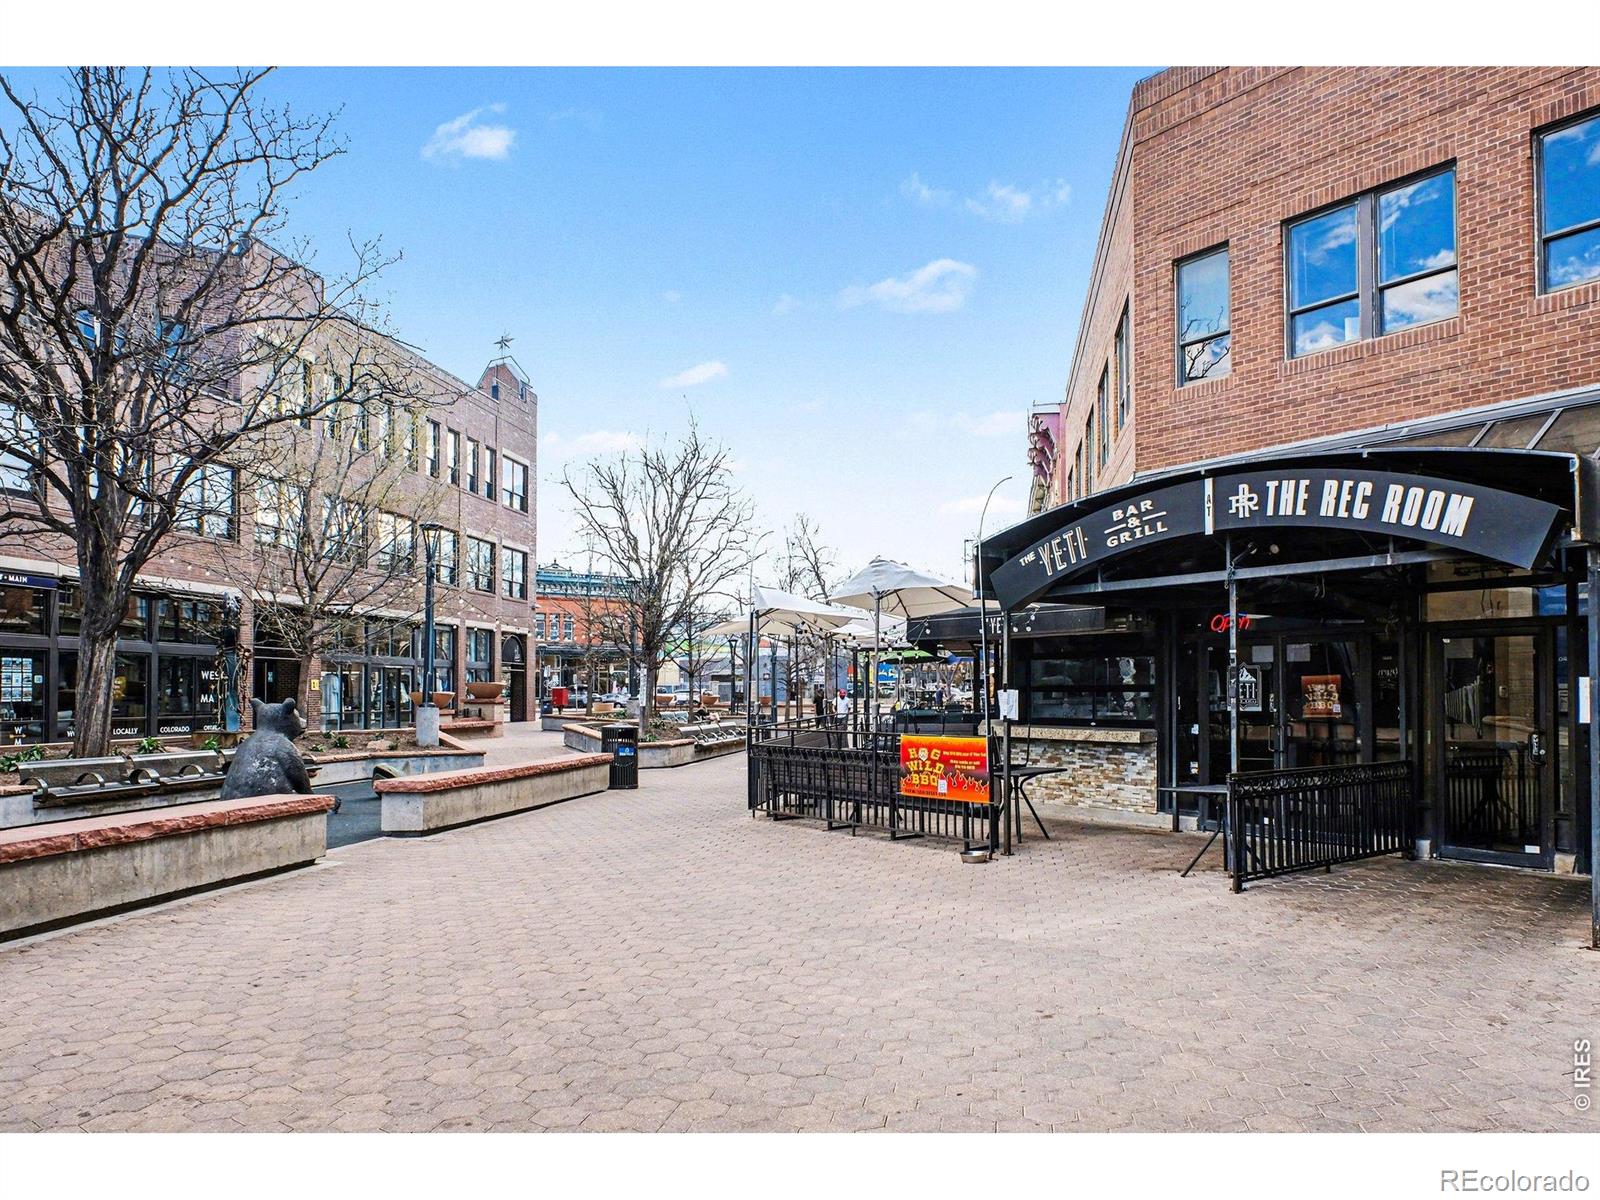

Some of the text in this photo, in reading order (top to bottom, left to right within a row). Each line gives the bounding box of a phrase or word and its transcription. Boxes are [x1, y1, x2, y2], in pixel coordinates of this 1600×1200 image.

[1112, 500, 1153, 522] BAR
[1206, 494, 1213, 518] AT
[1266, 480, 1310, 516] THE
[1320, 480, 1373, 520] REC
[1381, 484, 1474, 537] ROOM
[1127, 516, 1141, 528] &
[1106, 521, 1168, 548] GRILL
[1019, 551, 1037, 567] THE
[8, 574, 28, 583] MAIN
[14, 726, 22, 734] W
[113, 727, 138, 735] LOCALLY
[160, 725, 190, 734] COLORADO
[906, 759, 945, 774] WILD
[912, 773, 938, 787] BBQ
